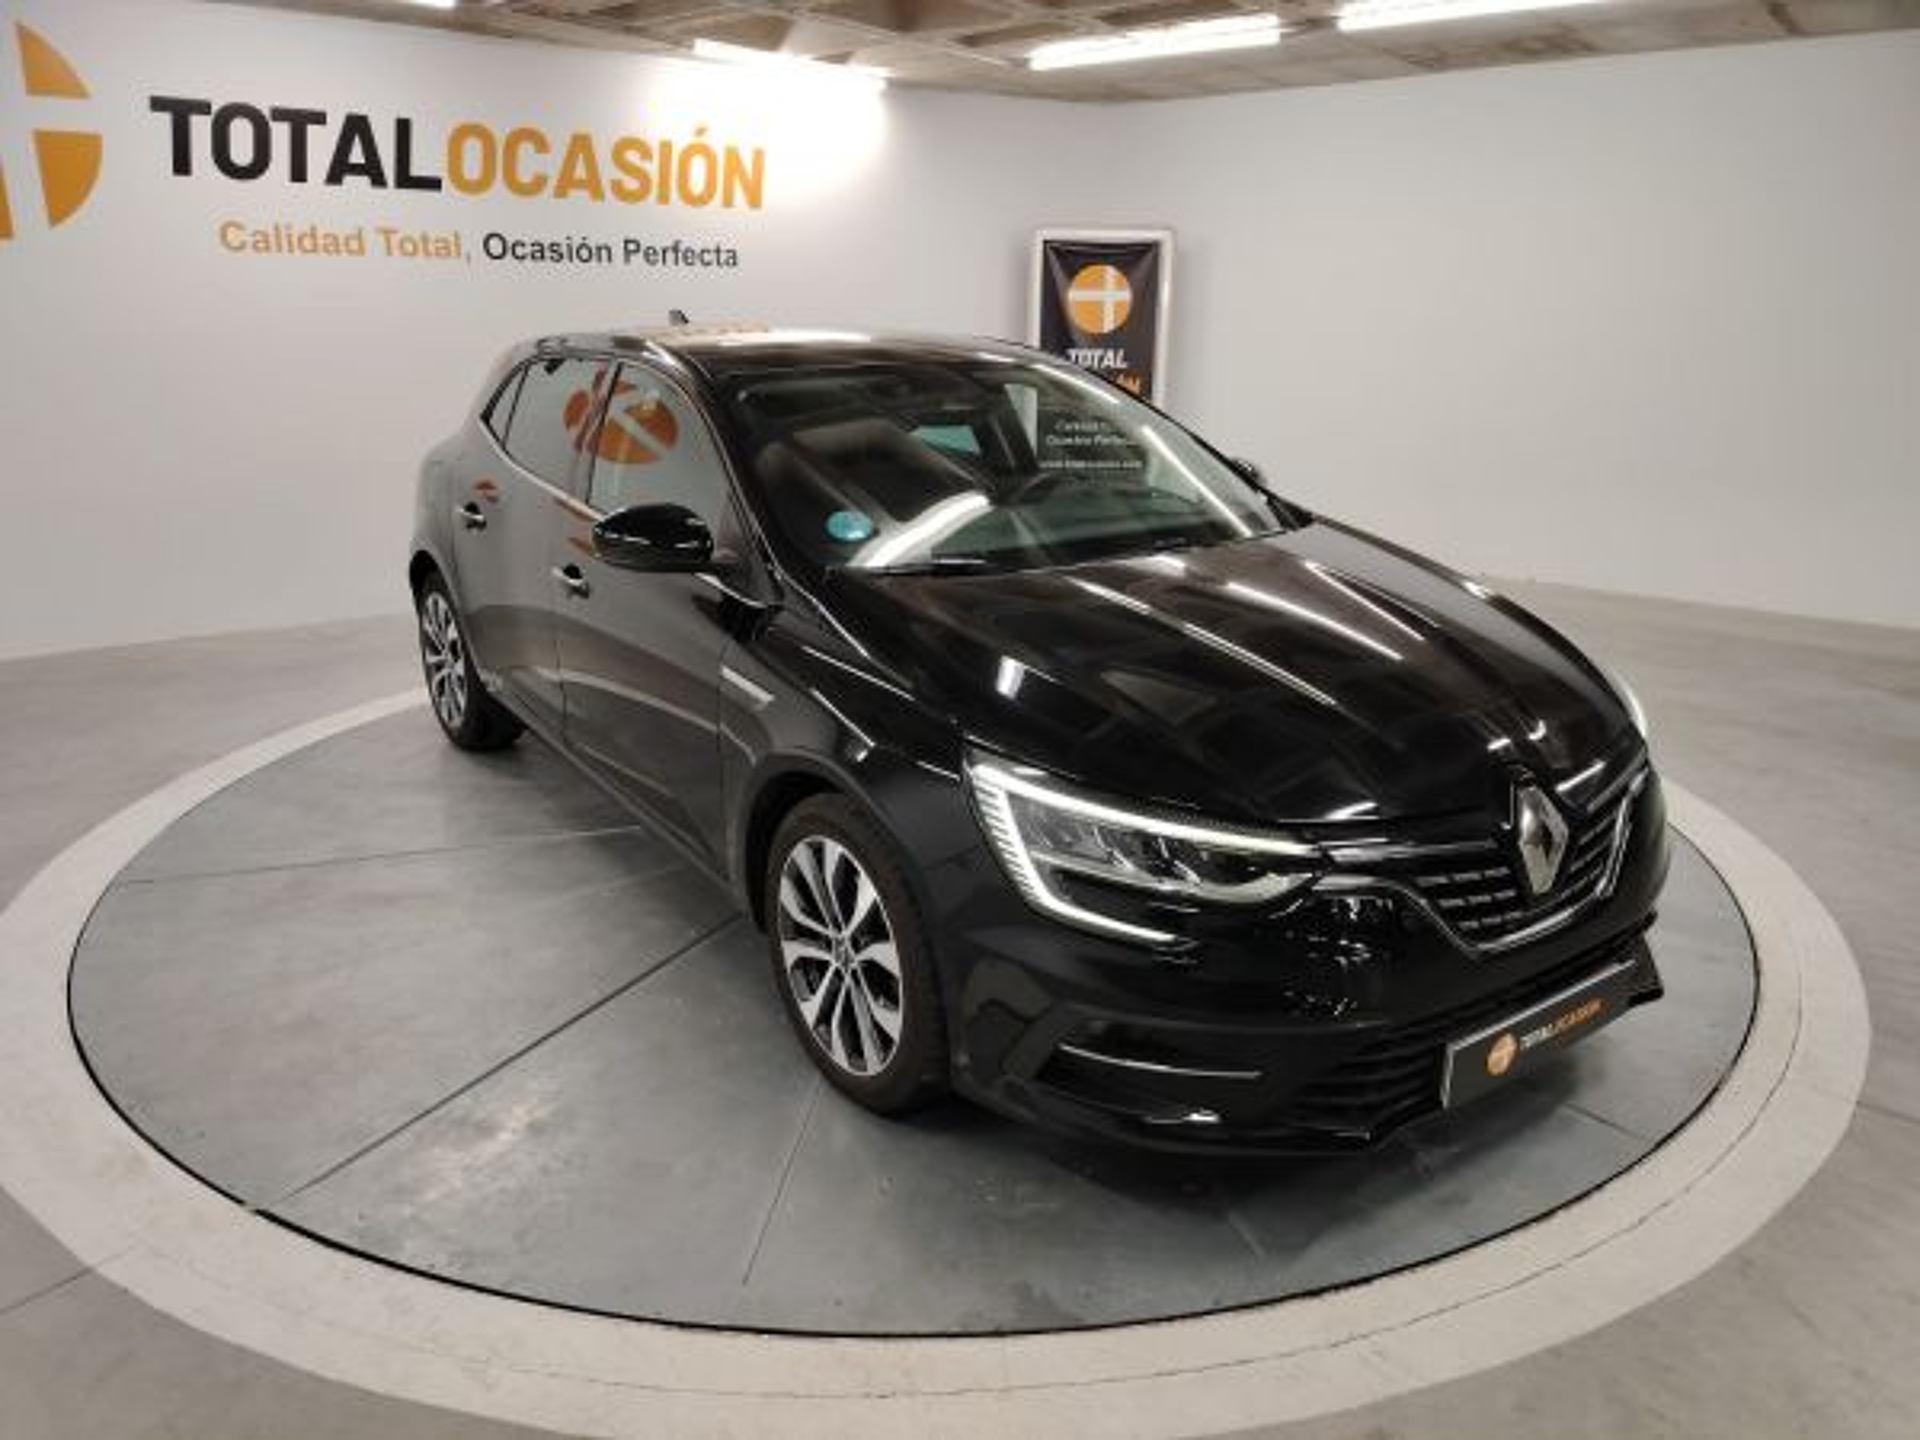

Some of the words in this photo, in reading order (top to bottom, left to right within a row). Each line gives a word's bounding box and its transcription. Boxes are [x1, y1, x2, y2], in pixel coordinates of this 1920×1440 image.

[219, 220, 365, 256] Calidad
[381, 227, 472, 265] Total,
[483, 232, 613, 265] Ocasión
[624, 239, 739, 268] Perfecta
[1067, 348, 1127, 370] TOTAL
